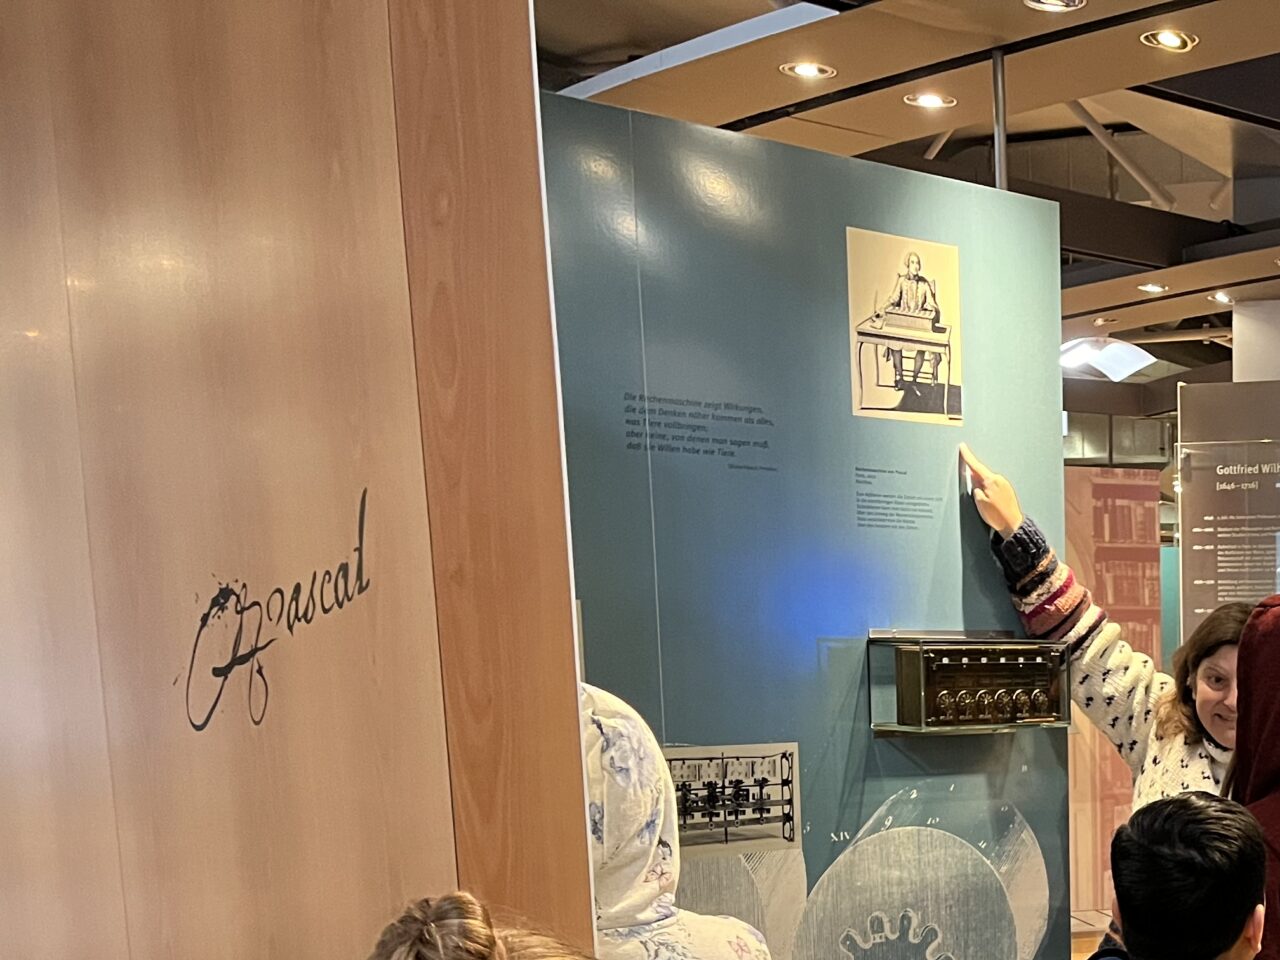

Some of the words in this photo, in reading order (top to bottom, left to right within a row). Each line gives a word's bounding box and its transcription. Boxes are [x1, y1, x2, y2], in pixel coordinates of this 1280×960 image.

[624, 392, 637, 401] Die
[658, 408, 686, 418] Denken
[711, 412, 742, 423] kommen
[626, 430, 643, 438] aber
[730, 438, 753, 448] sagen
[658, 443, 681, 452] Willen
[682, 446, 700, 455] habe
[1216, 464, 1259, 475] Gottfried
[910, 789, 919, 799] 2
